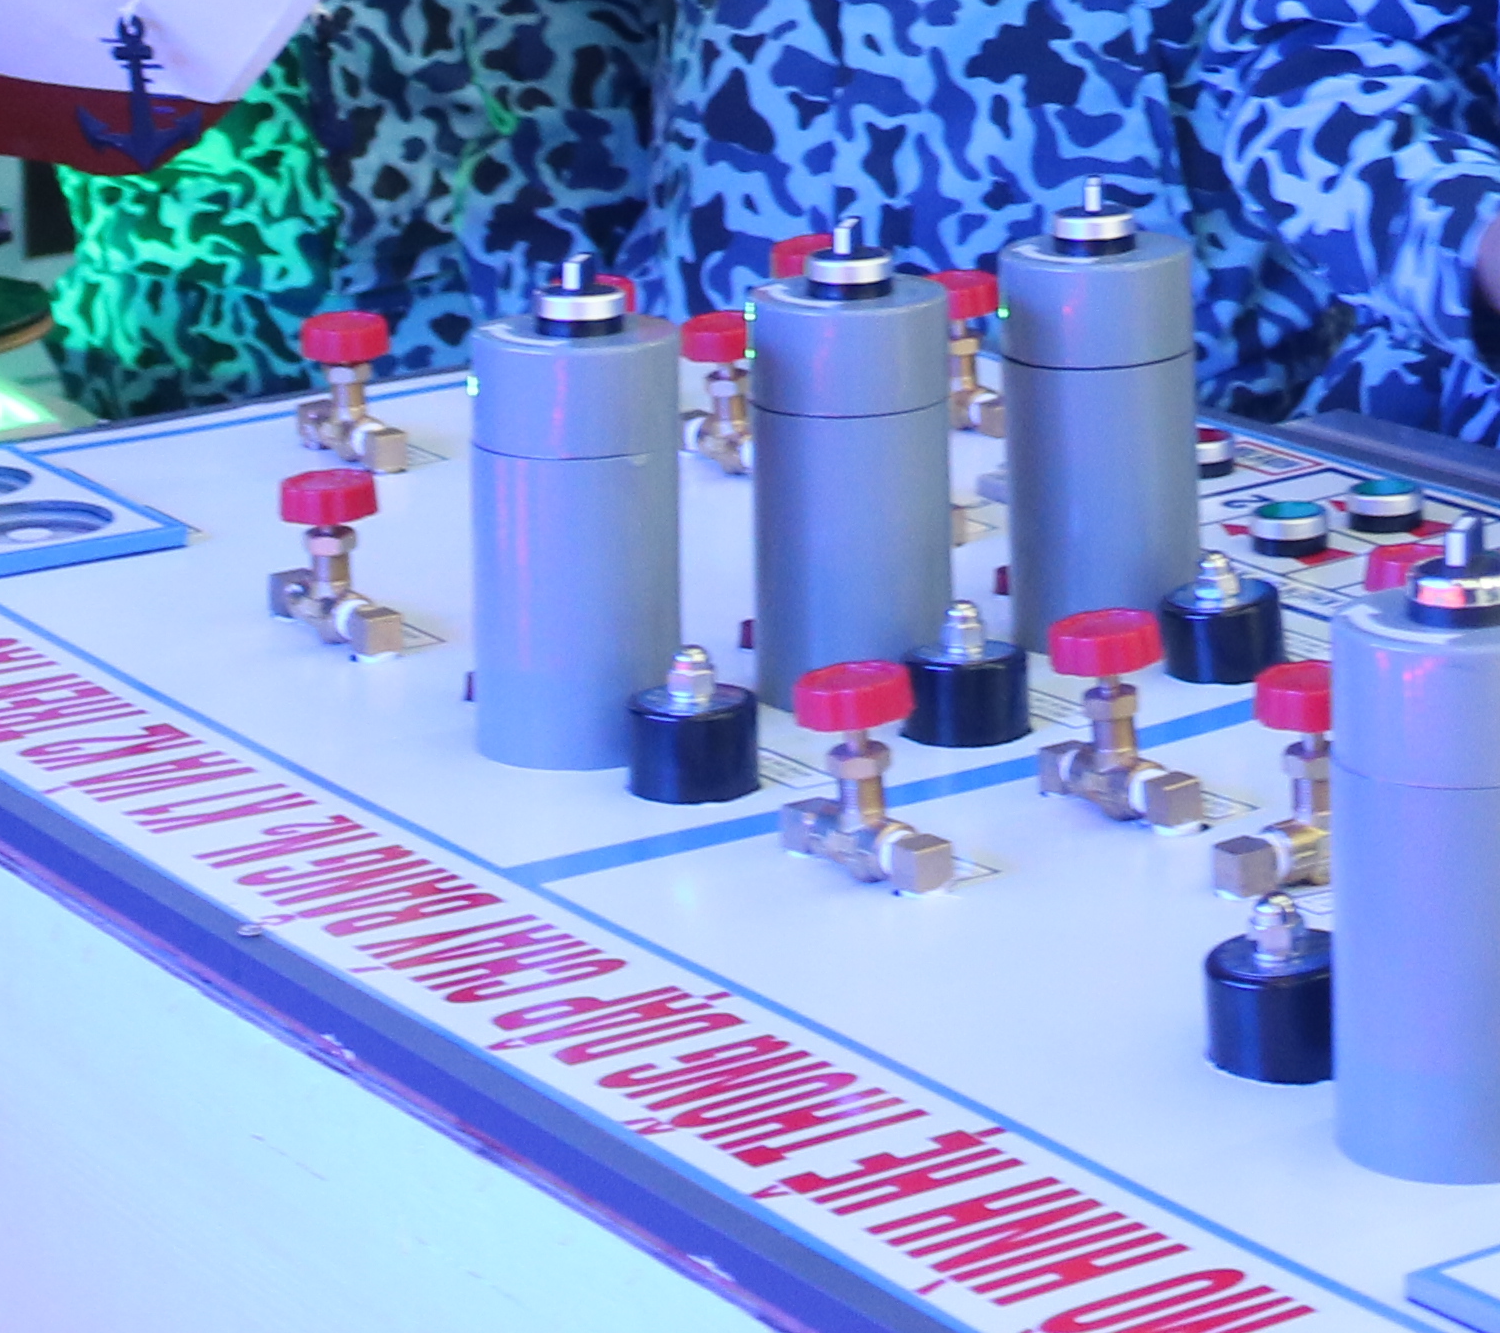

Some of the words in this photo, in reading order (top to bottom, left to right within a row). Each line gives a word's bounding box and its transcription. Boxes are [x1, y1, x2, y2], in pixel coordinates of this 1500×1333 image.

[16, 721, 206, 773] K2
[41, 749, 258, 803] VÀ
[121, 782, 320, 835] K1
[347, 912, 628, 1004] CHÁY
[596, 1033, 931, 1168] THỐNG
[749, 1126, 1028, 1217] HỆ
[864, 1175, 1193, 1308] HÌNH
